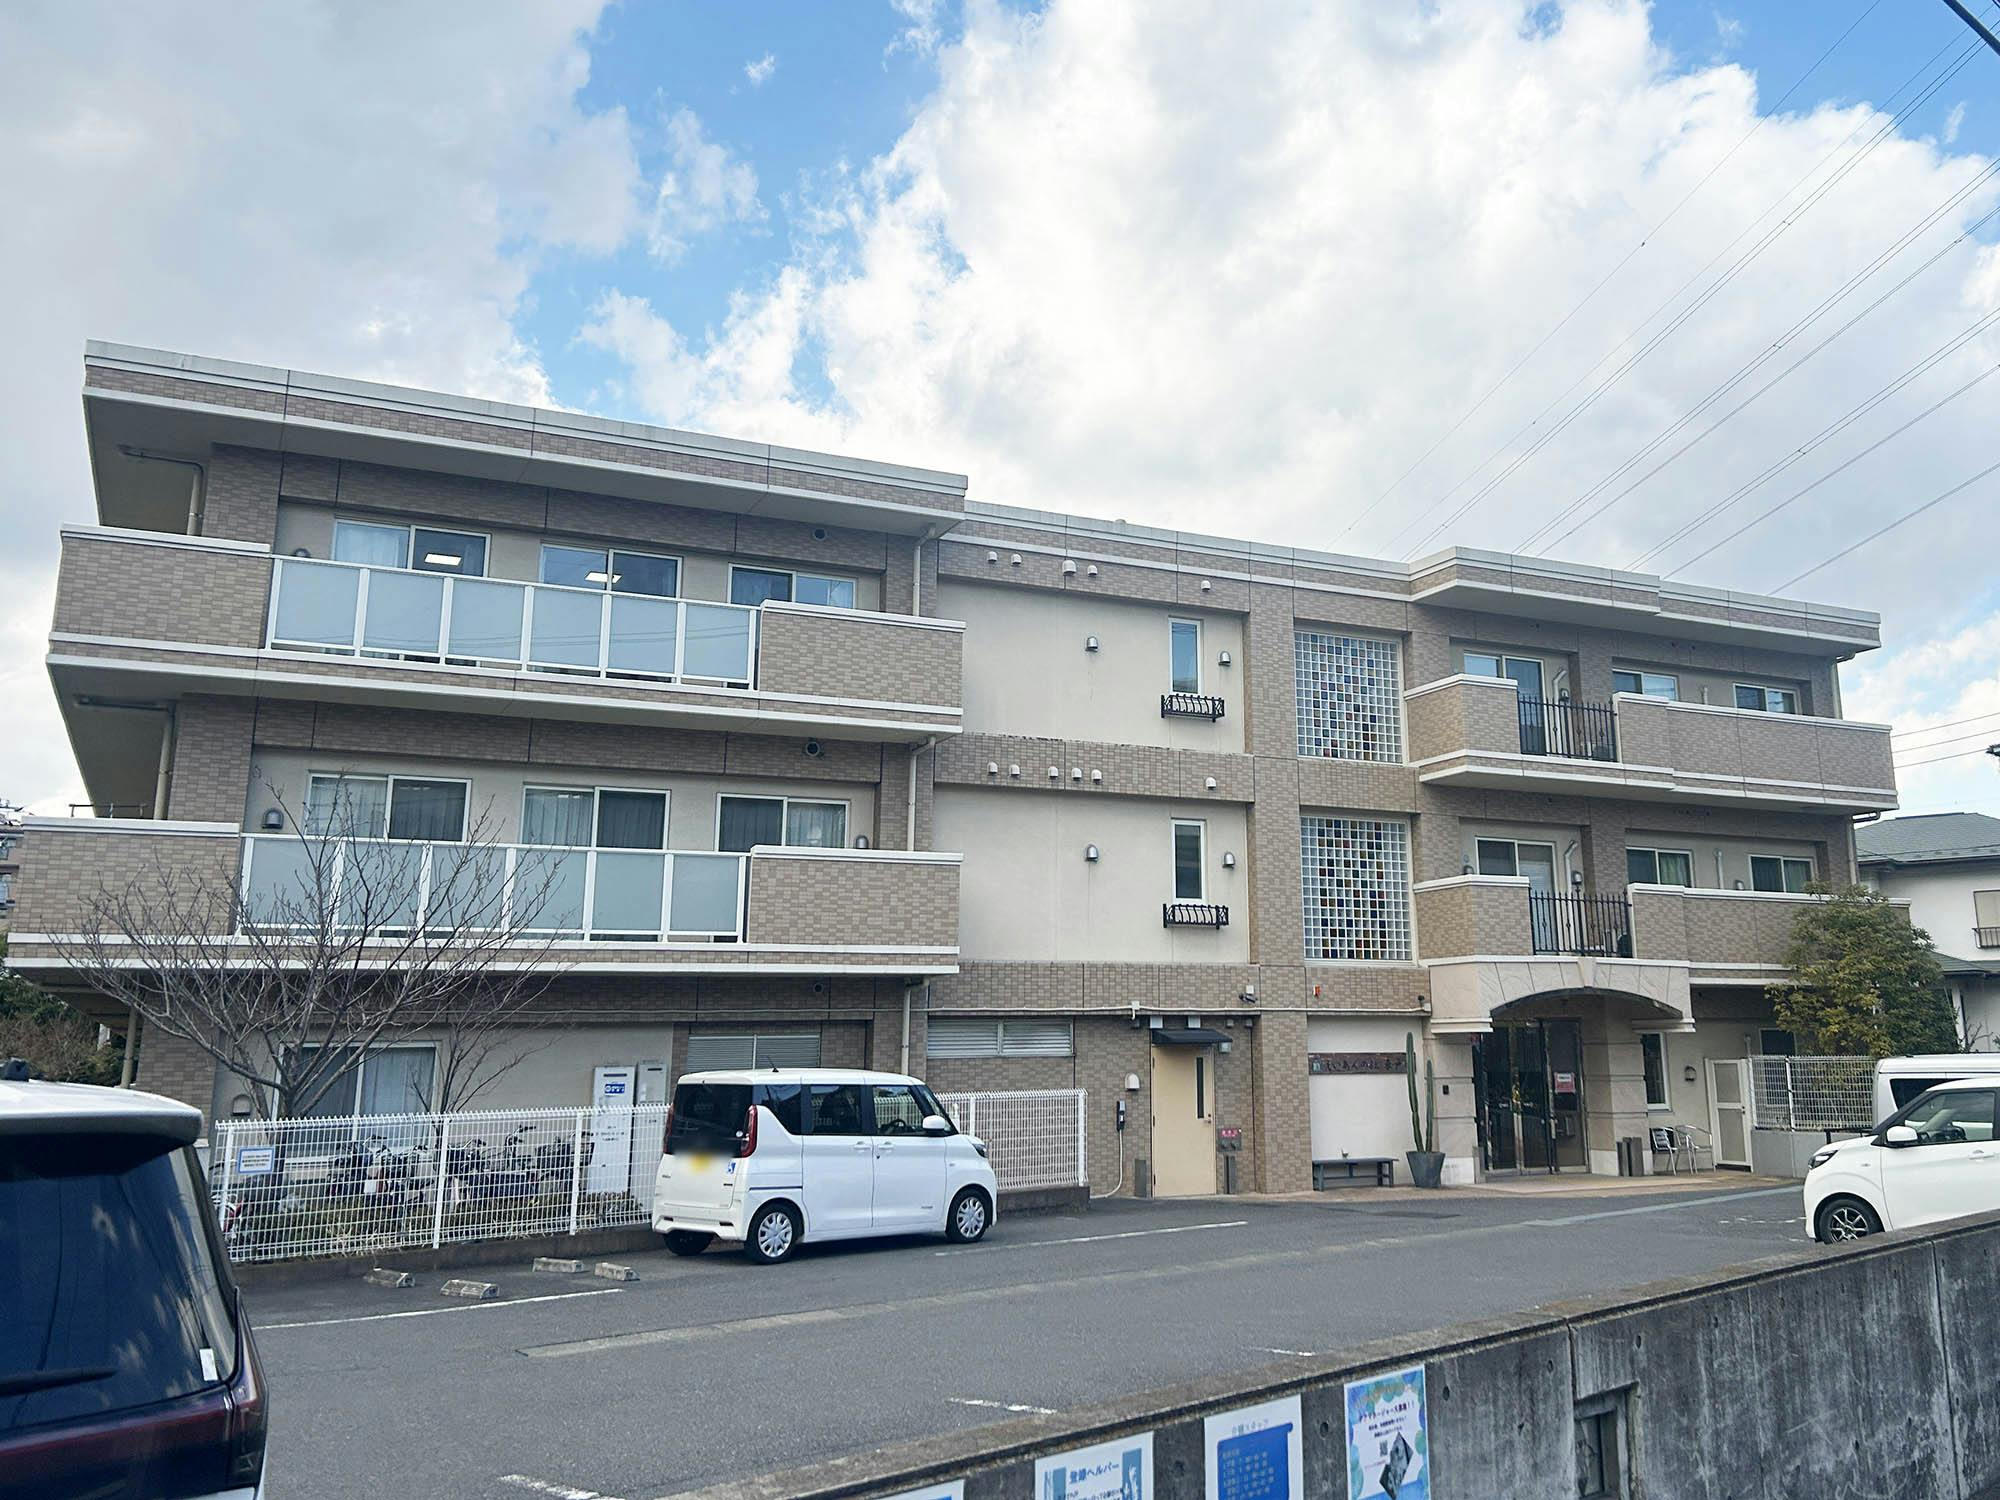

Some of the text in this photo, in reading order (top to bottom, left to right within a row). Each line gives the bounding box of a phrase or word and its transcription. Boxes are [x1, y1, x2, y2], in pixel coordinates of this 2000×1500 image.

[1069, 1461, 1120, 1485] 登録ヘルパー
